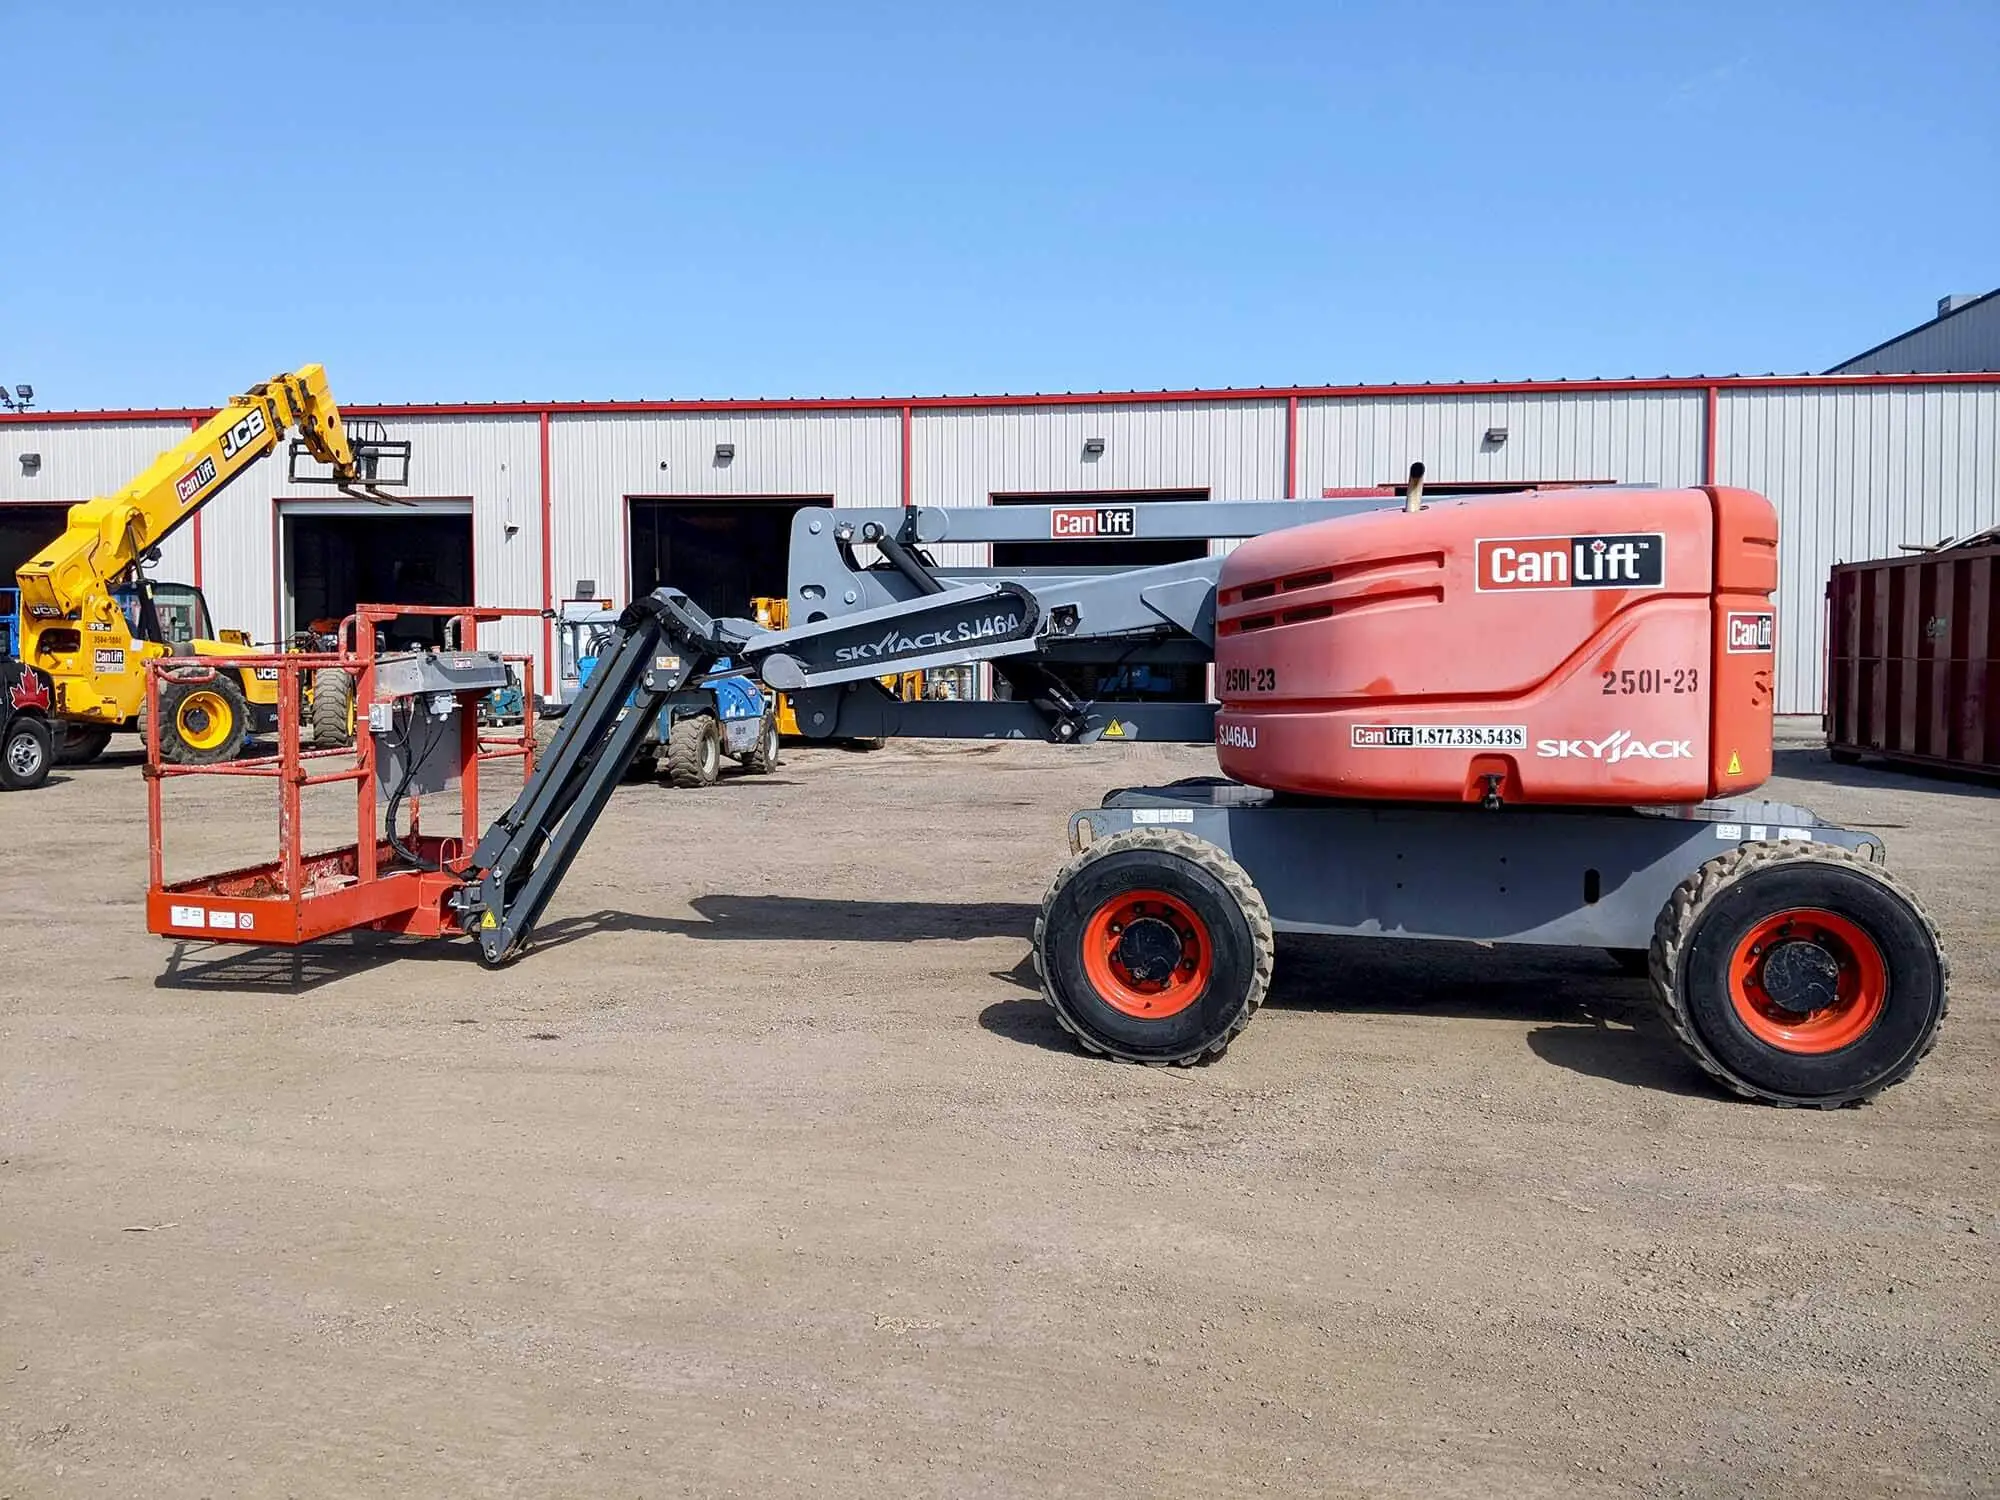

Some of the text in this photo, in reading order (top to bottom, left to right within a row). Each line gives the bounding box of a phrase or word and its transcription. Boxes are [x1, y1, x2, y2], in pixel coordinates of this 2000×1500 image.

[220, 408, 266, 459] JCB
[32, 607, 60, 615] JCB
[834, 630, 954, 663] SKYJACK
[256, 668, 278, 680] JCB
[1226, 668, 1276, 692] 2501-23
[1602, 668, 1699, 696] 2501-23
[1219, 724, 1258, 749] SJ46AJ
[1416, 729, 1523, 745] 1.877.338.5438
[1536, 730, 1694, 764] SKYJACK
